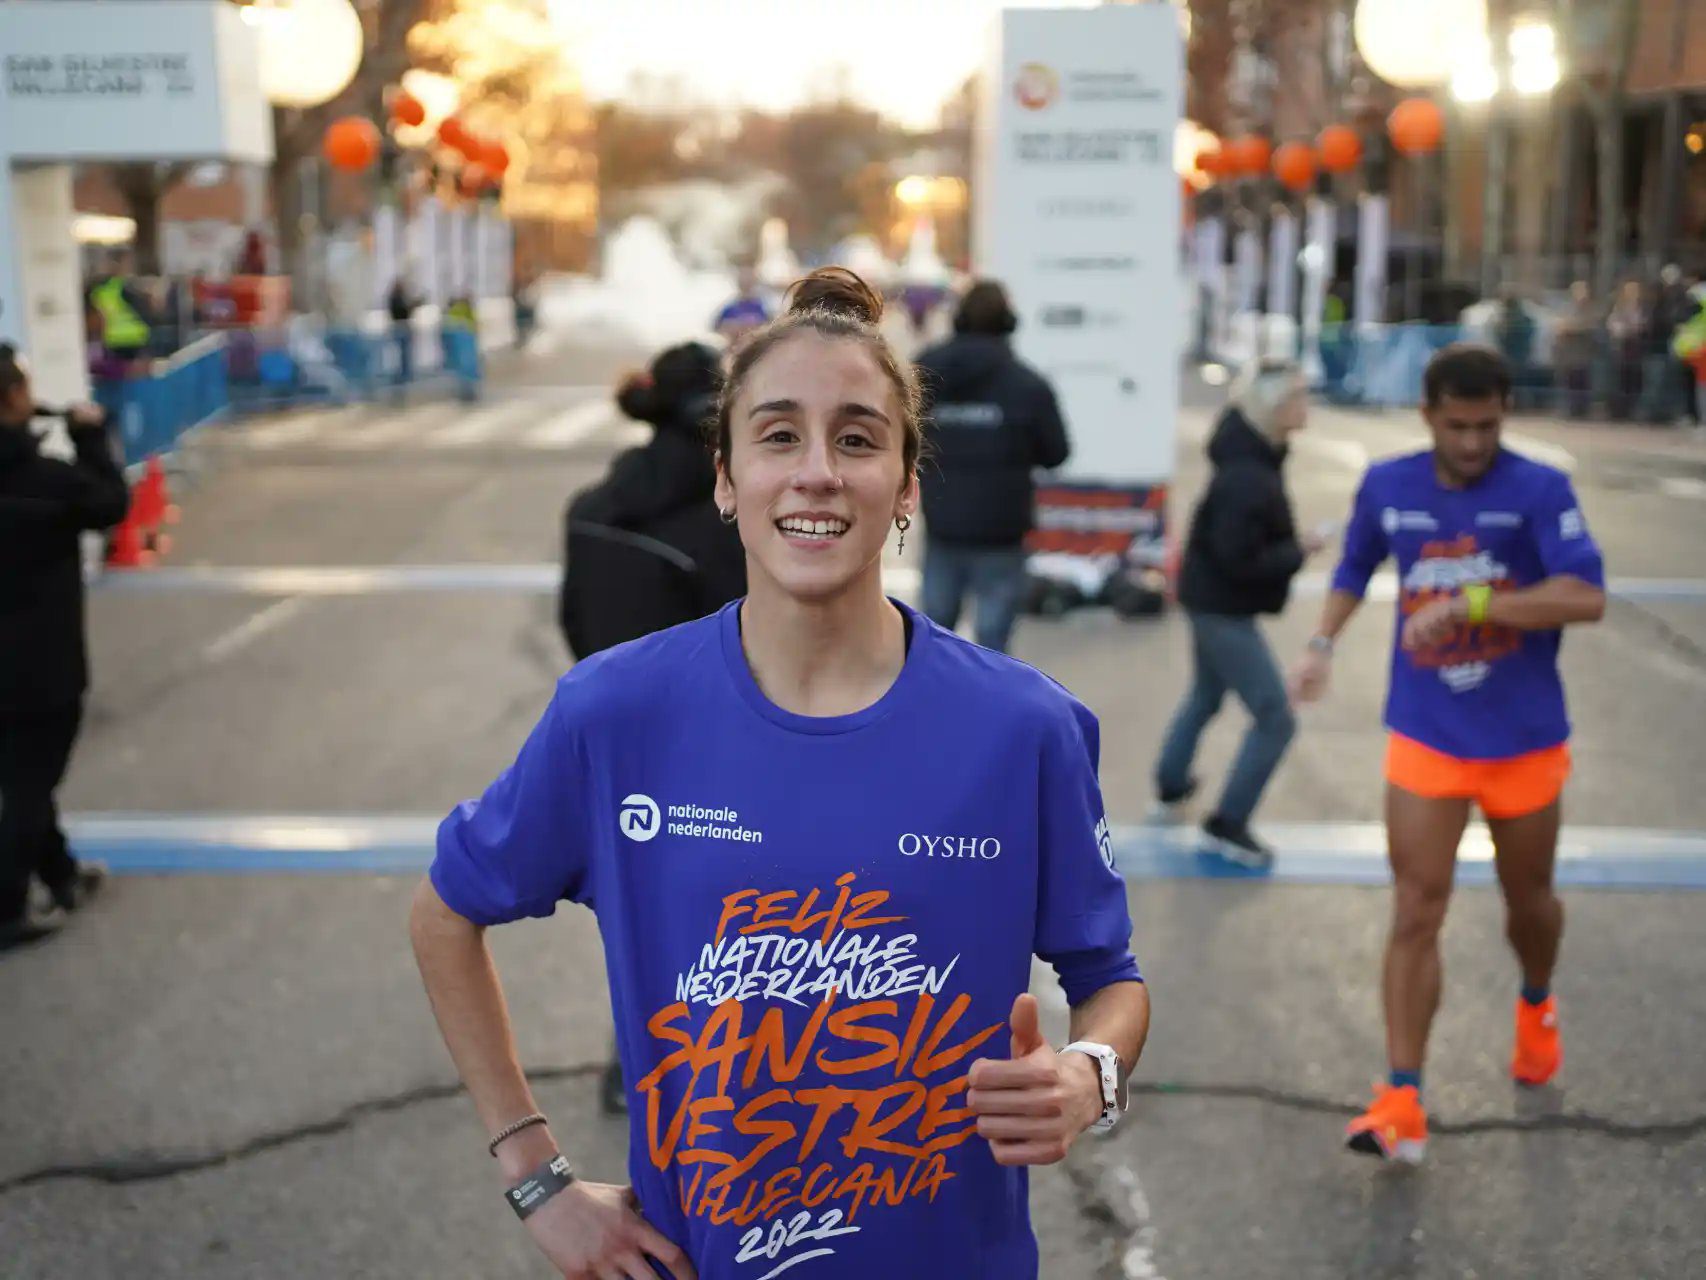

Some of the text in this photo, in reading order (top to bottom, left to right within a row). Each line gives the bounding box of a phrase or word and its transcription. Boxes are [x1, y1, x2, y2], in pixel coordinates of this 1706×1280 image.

[668, 804, 738, 822] nationale
[668, 821, 762, 843] nederlanden
[899, 833, 1001, 859] OYSHO
[699, 928, 917, 977] NATIONALE
[675, 953, 960, 1008] NEDERLANDEN
[637, 1068, 979, 1188] VESTRE
[679, 1153, 957, 1227] VALLECANA
[735, 1209, 861, 1263] 2022
